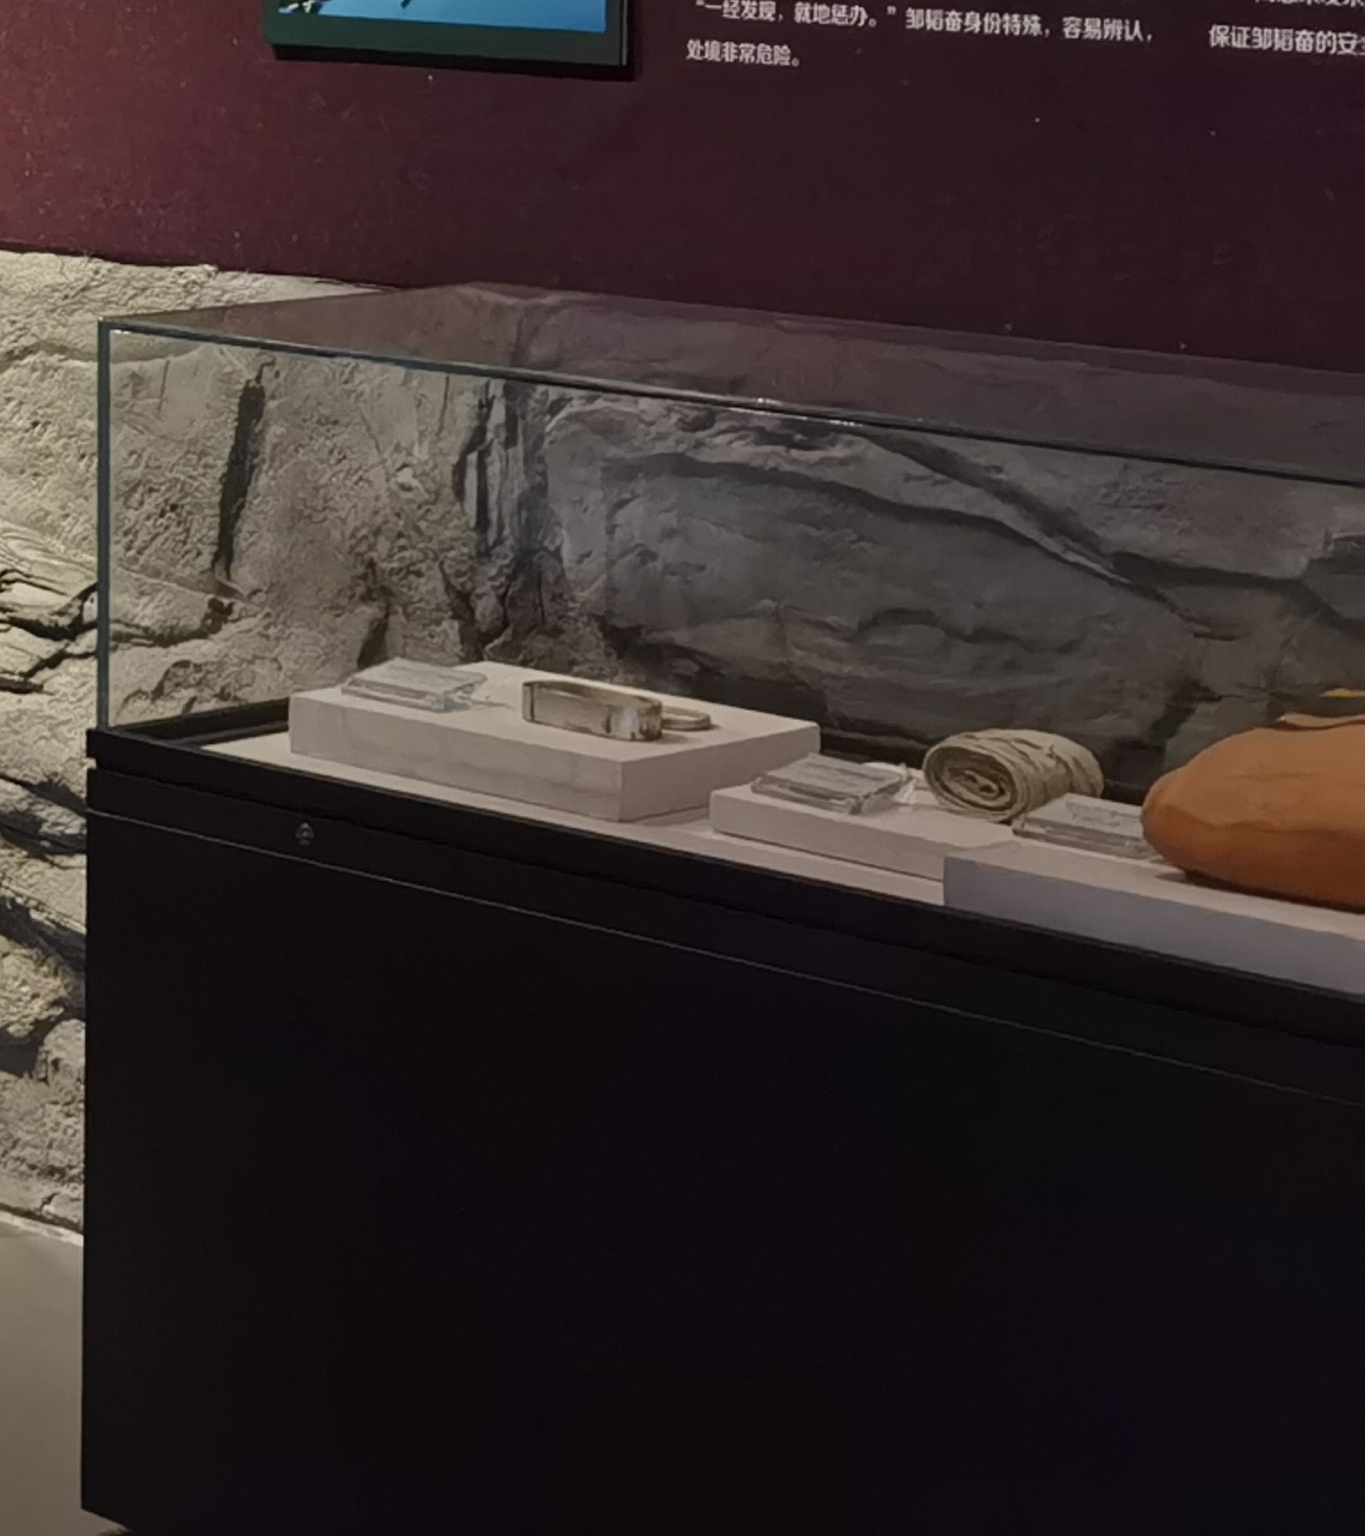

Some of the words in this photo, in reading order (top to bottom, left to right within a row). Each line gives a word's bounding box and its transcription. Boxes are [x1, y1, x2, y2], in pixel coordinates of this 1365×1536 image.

[686, 39, 801, 68] 处境非常危险。
